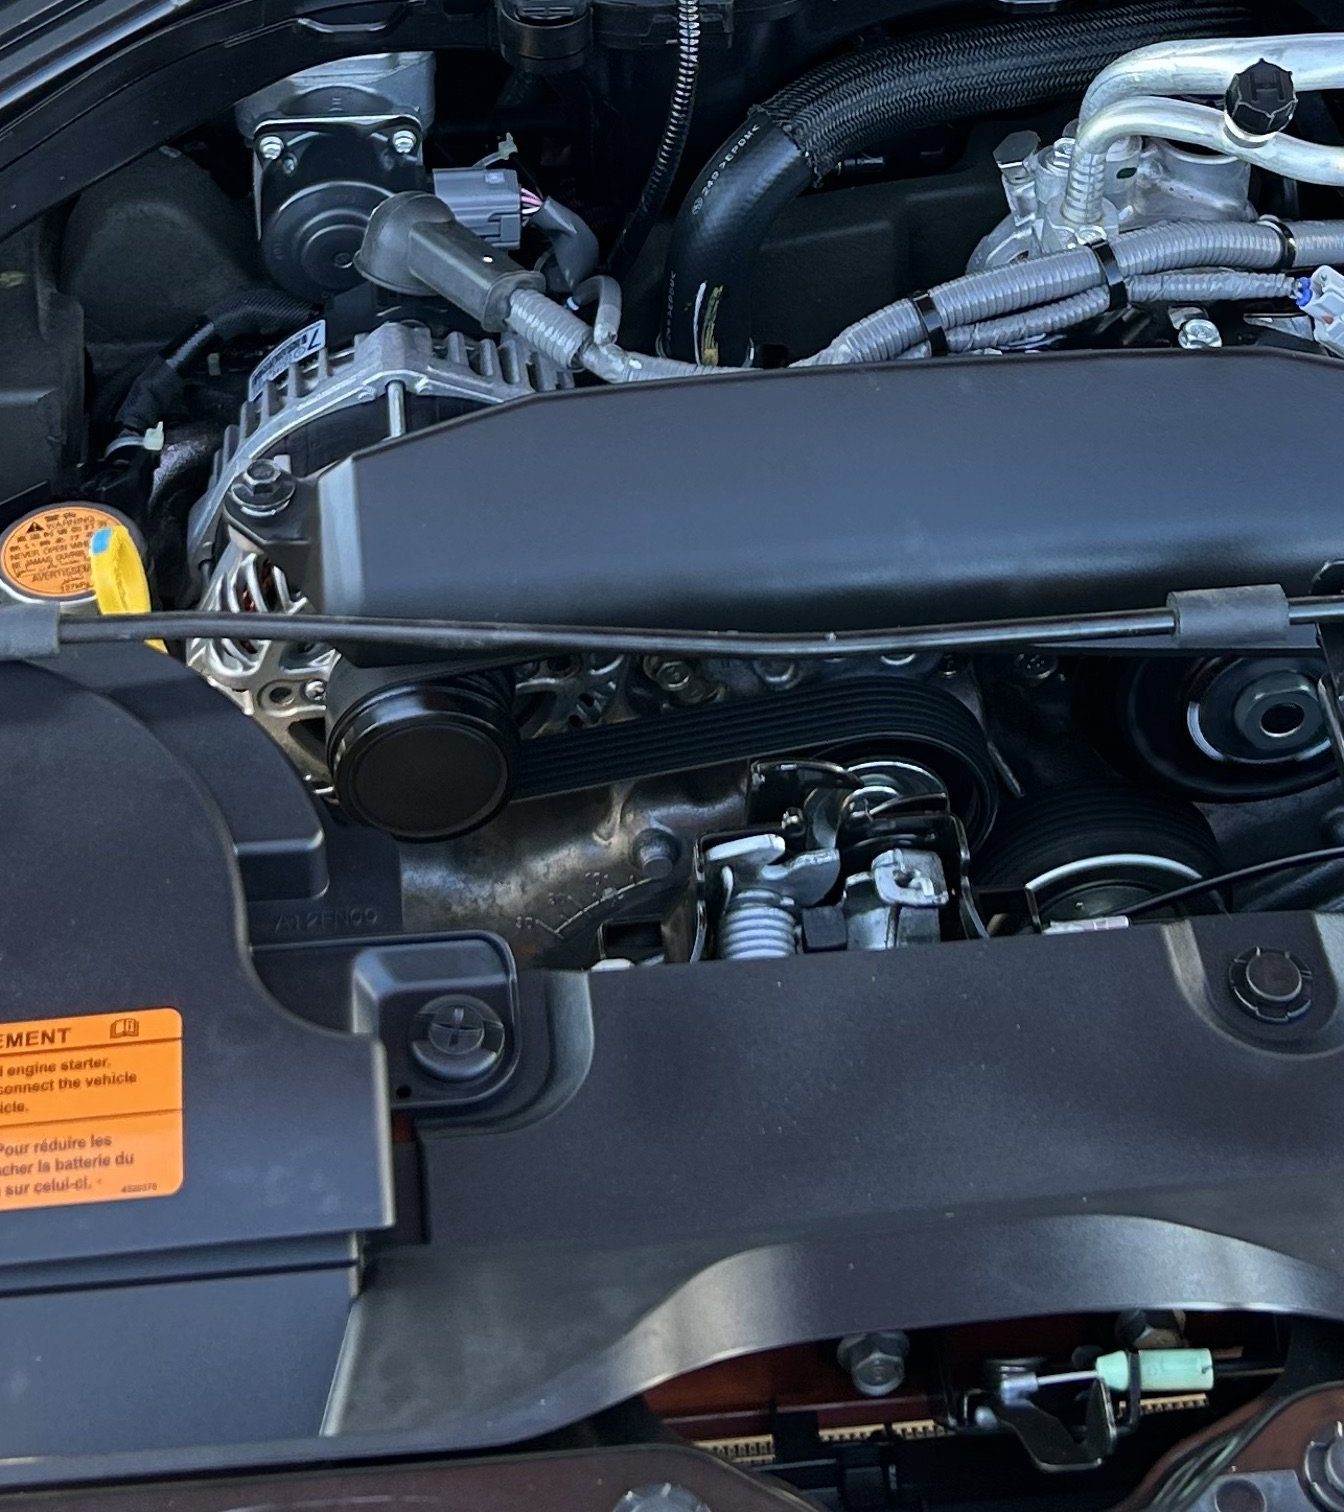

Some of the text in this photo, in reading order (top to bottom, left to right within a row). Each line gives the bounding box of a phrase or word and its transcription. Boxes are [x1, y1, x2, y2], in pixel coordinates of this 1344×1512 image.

[7, 1061, 57, 1081] engine
[60, 1056, 112, 1073] starter.
[58, 1076, 82, 1090] the
[84, 1070, 138, 1087] vehicle
[32, 1133, 87, 1154] réduire
[89, 1131, 113, 1148] les
[36, 1157, 52, 1173] la
[54, 1150, 112, 1172] batterie
[114, 1149, 135, 1166] du
[5, 1180, 31, 1197] sur
[33, 1175, 93, 1195] celui-ci.
